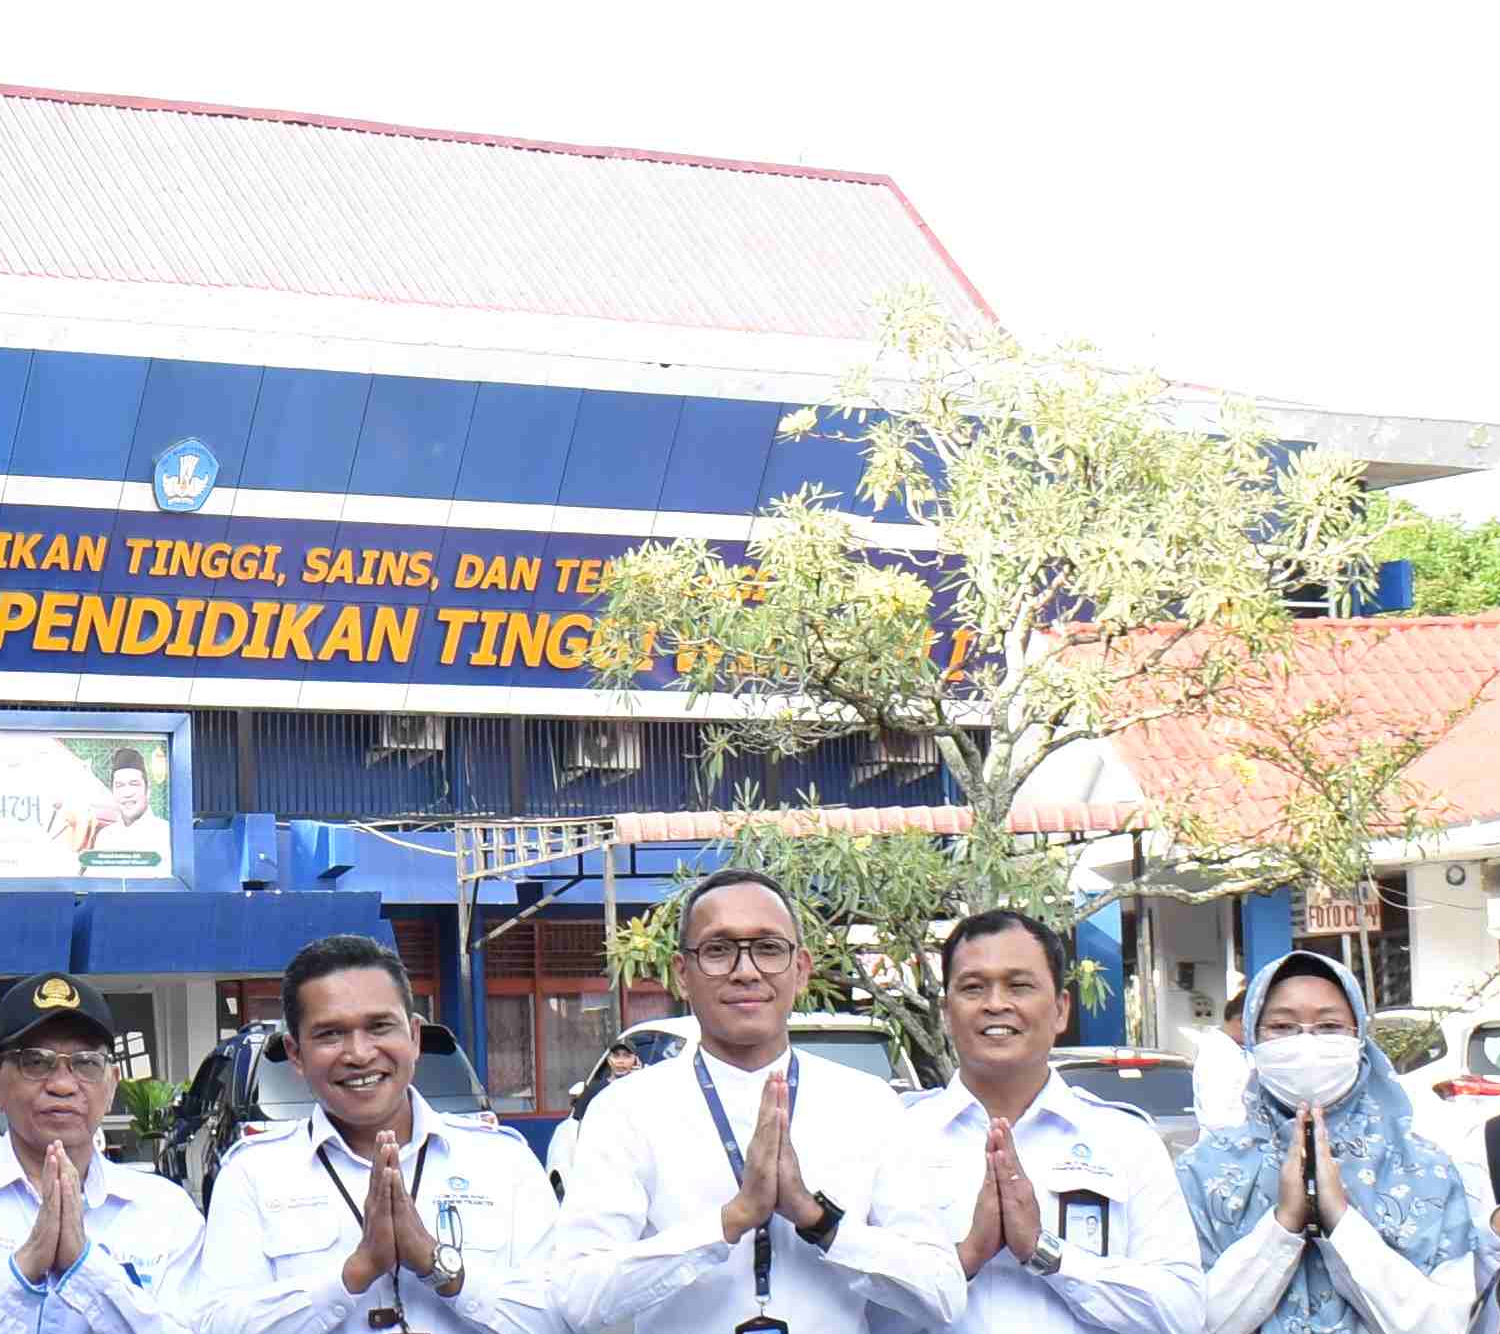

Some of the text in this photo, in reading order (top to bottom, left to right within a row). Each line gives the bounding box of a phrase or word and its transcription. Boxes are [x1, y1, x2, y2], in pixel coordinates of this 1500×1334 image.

[126, 538, 285, 587] TINGGI,
[303, 546, 440, 591] SAINS,
[455, 553, 542, 593] DAN
[1308, 905, 1341, 928] FOTO
